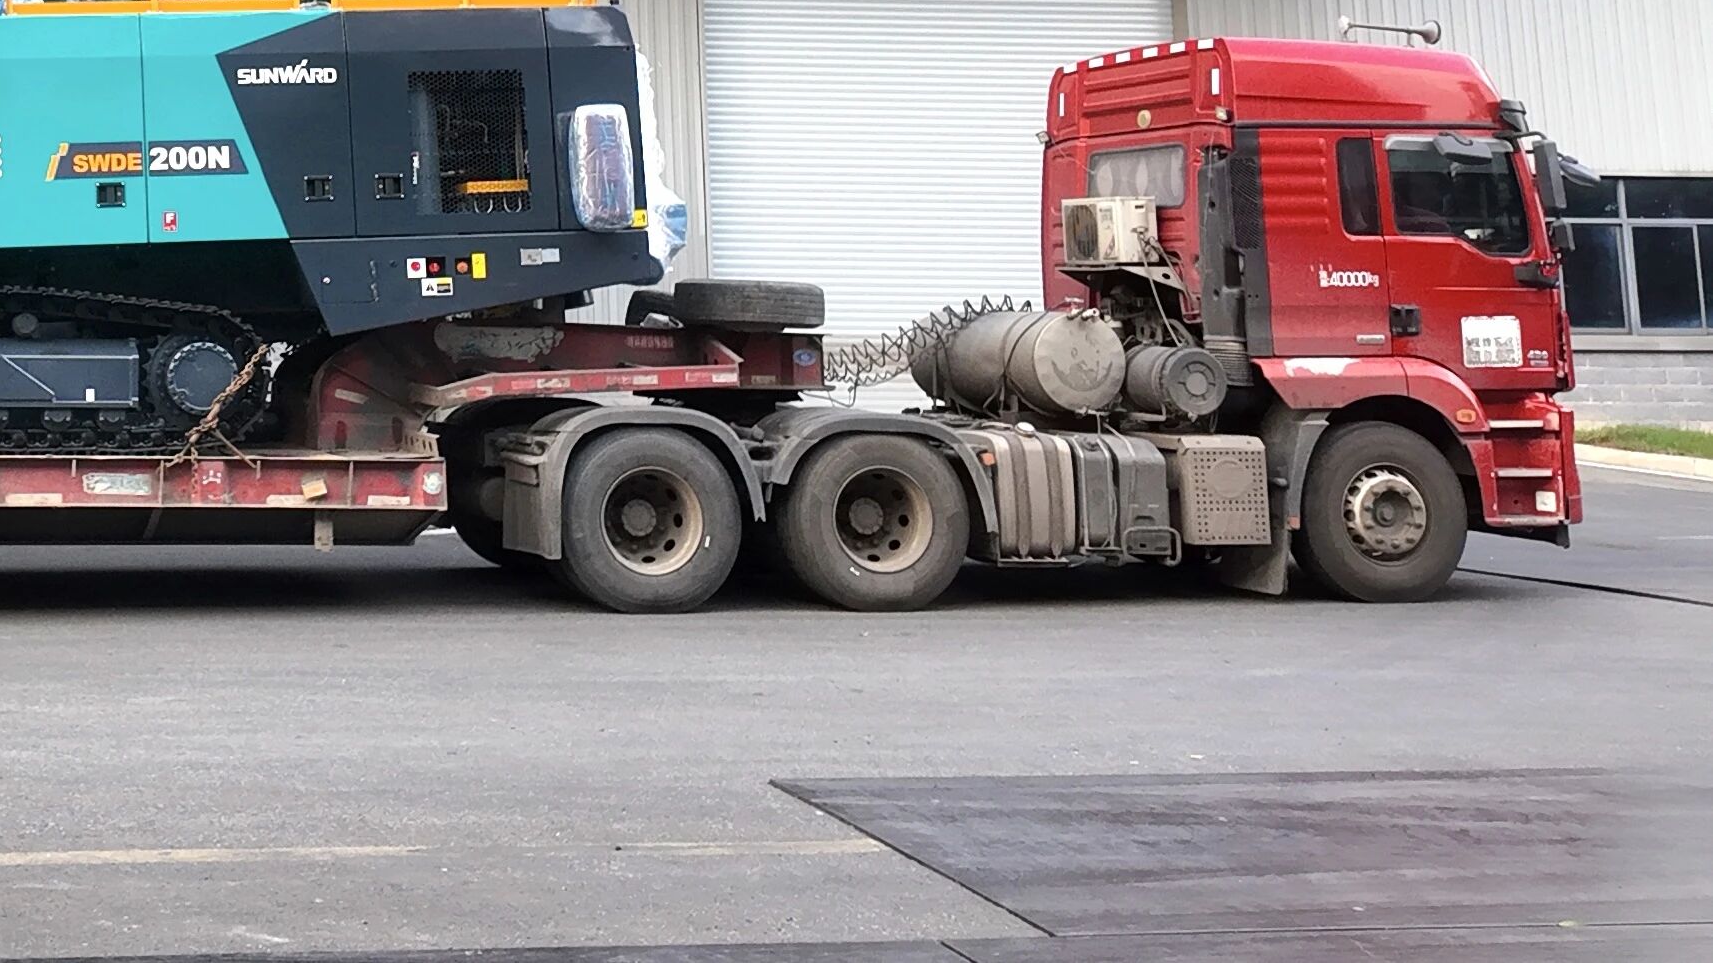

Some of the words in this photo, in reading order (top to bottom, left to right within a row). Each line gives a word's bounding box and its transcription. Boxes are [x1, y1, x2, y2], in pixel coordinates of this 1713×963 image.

[237, 59, 337, 85] SUNWARD
[72, 152, 143, 174] SWDE
[149, 145, 231, 172] 200N
